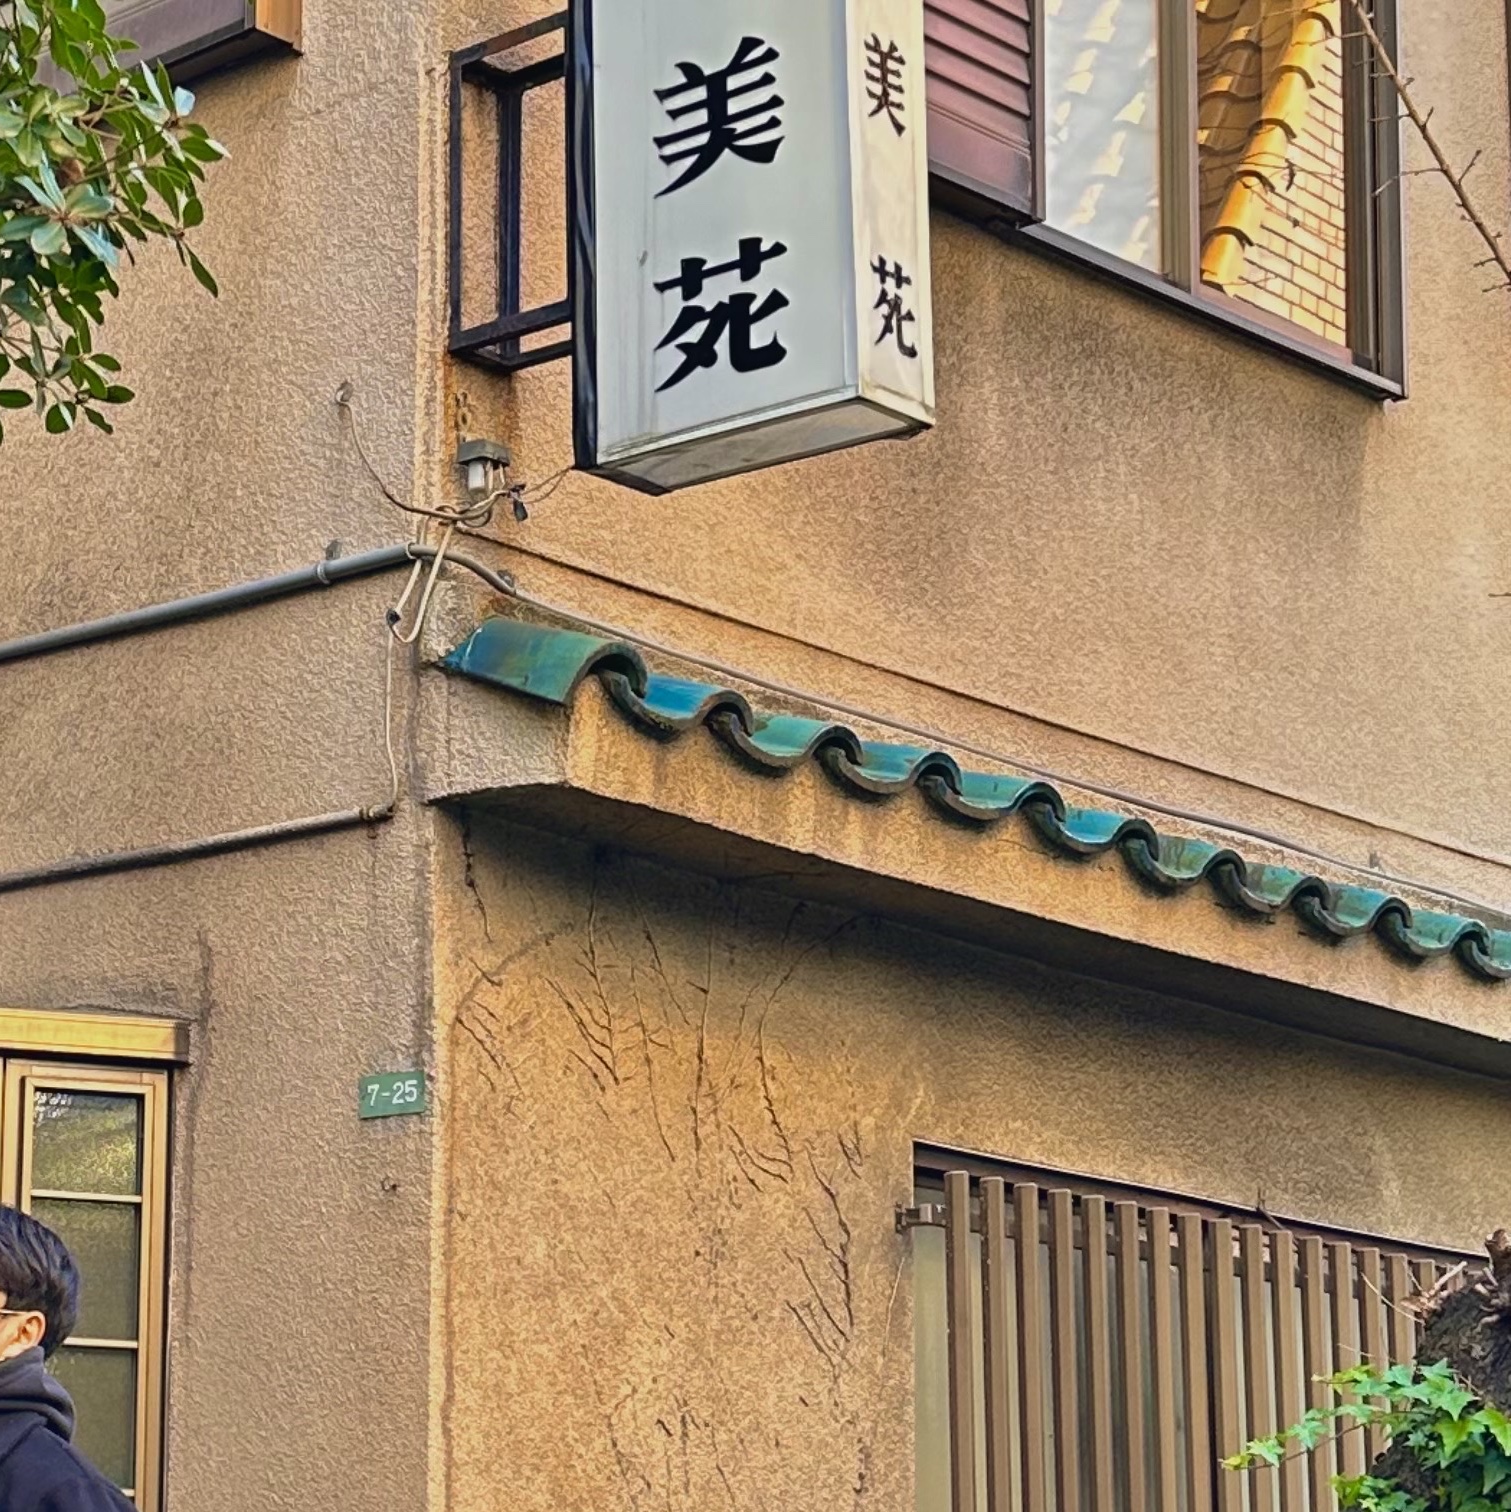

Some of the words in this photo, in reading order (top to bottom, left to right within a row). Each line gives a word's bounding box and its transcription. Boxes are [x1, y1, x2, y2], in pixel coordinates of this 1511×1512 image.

[652, 36, 790, 392] 美苑
[862, 33, 919, 359] 美苑
[367, 1079, 418, 1107] 7-25
